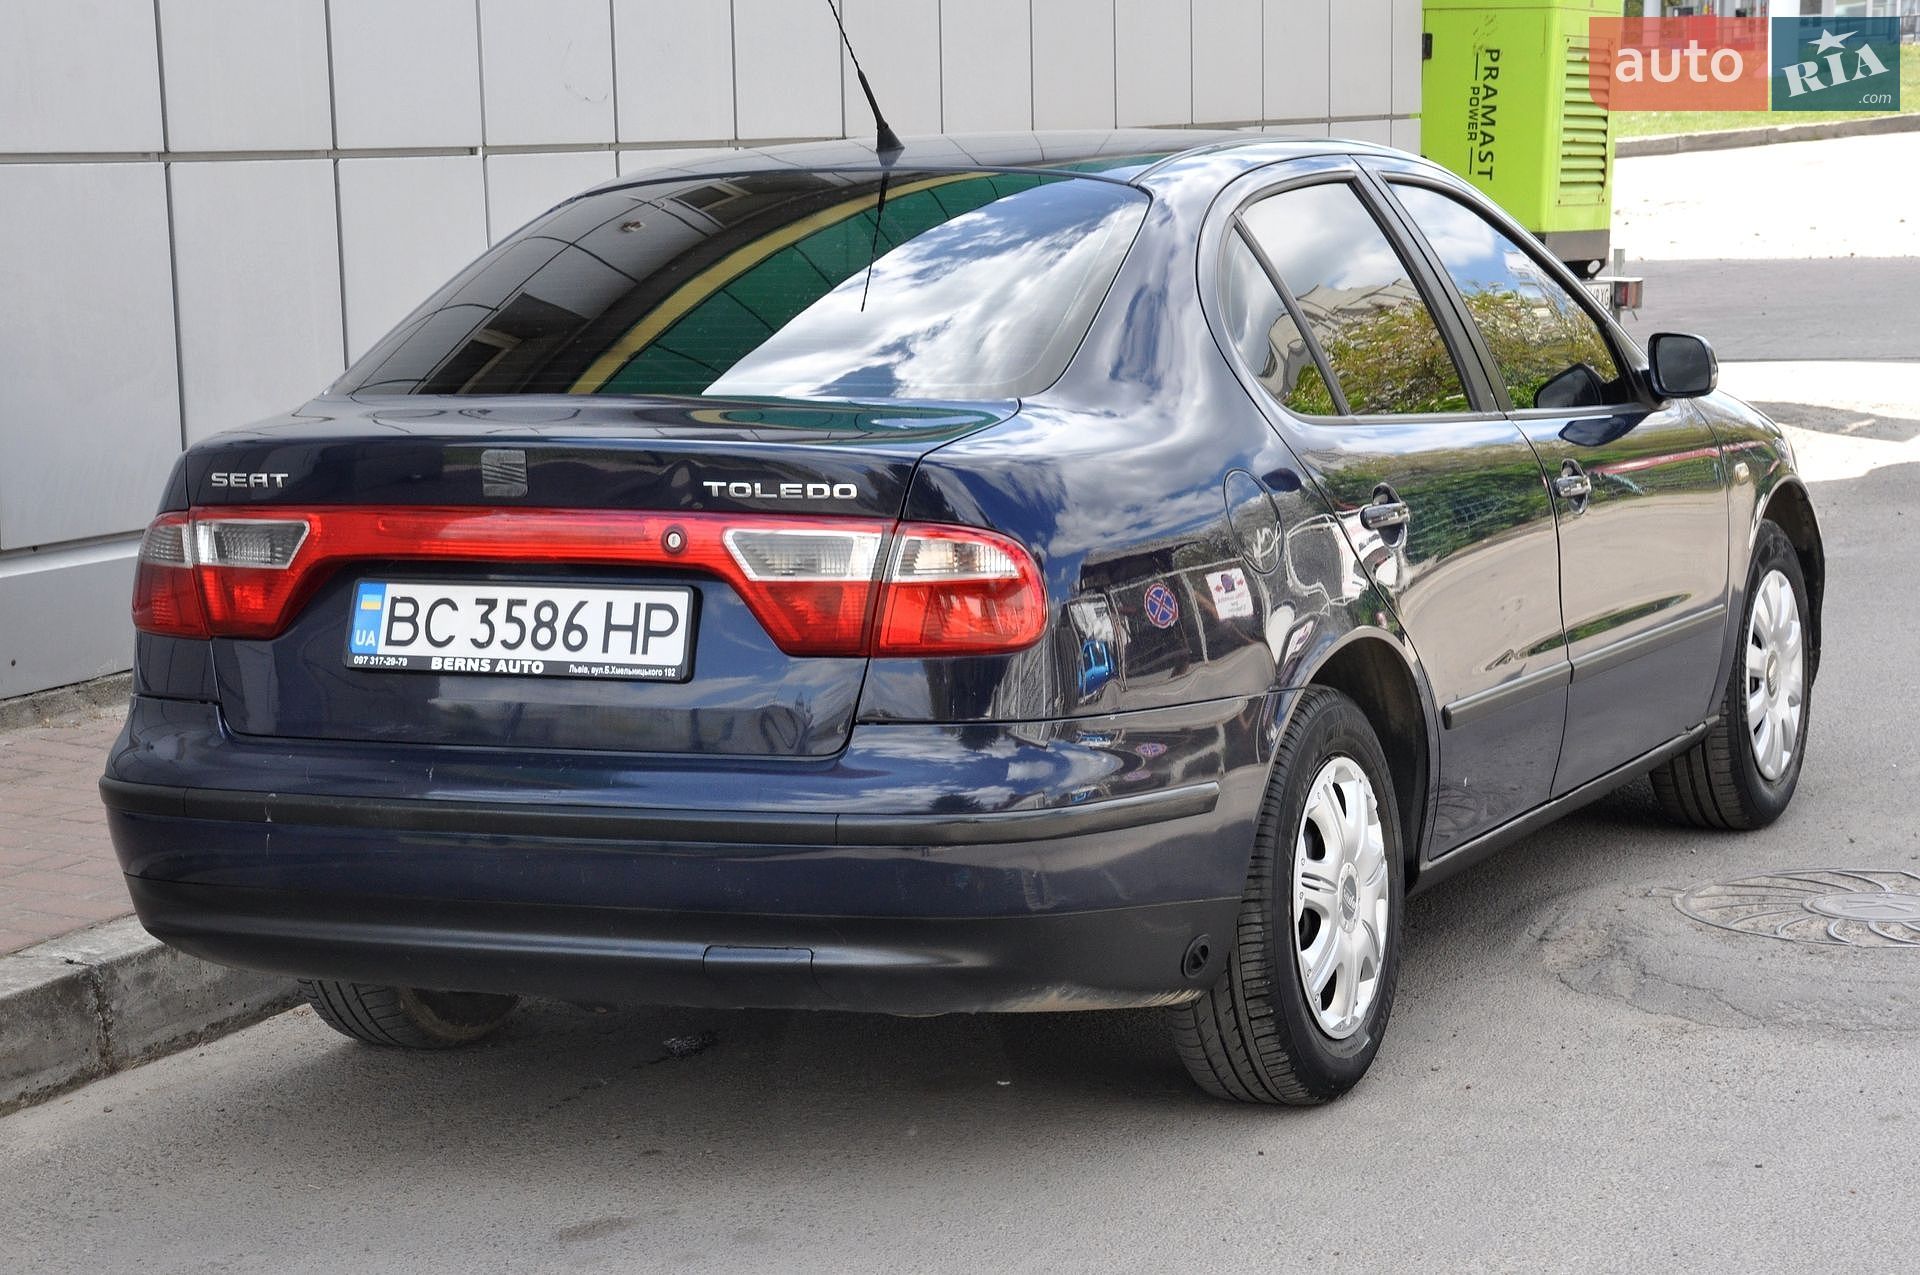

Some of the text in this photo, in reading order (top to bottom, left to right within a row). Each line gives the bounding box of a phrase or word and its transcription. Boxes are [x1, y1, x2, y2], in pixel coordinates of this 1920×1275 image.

[1467, 86, 1480, 141] POWER
[1477, 48, 1501, 181] PRAMAST
[211, 472, 289, 488] SEAT
[702, 481, 858, 500] TOLEDO
[385, 596, 680, 656] BC 3586 HP
[355, 629, 376, 647] UA
[353, 655, 368, 665] 097
[430, 656, 544, 674] BERNS AUTO
[664, 667, 676, 677] 192
